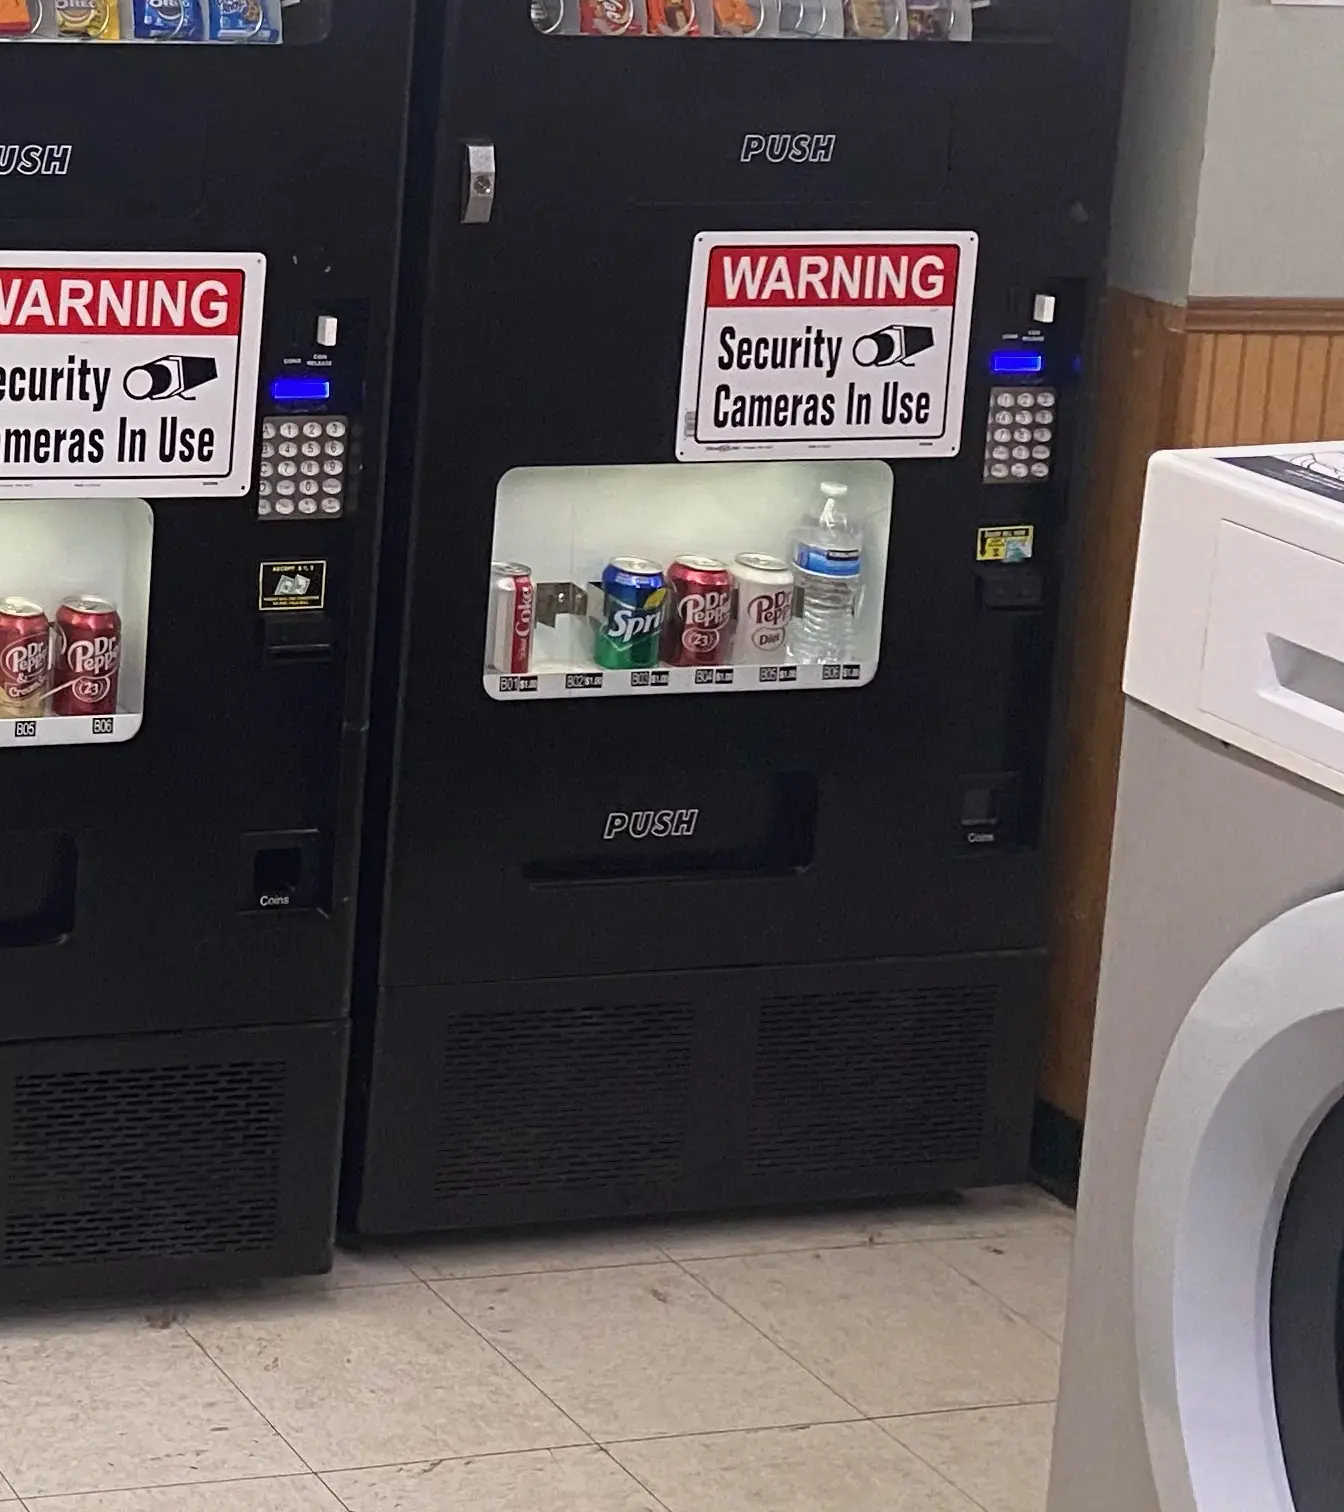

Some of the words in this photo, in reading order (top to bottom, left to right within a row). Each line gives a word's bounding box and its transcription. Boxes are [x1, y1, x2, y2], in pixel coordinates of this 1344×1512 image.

[741, 134, 836, 162] PUSH
[723, 255, 945, 301] WARNING
[718, 326, 843, 378] Security
[714, 384, 835, 428] Cameras
[847, 383, 871, 425] In
[881, 381, 930, 425] Use
[117, 417, 146, 463] In
[159, 416, 214, 463] Use
[706, 592, 728, 610] Dr
[515, 586, 532, 637] Coke
[27, 641, 44, 654] Dr
[94, 637, 116, 655] Dr
[759, 633, 780, 646] Diet
[83, 682, 99, 694] 23
[16, 722, 35, 736] B05
[93, 719, 112, 733] B06
[603, 809, 698, 838] PUSH
[260, 895, 289, 906] Coins
